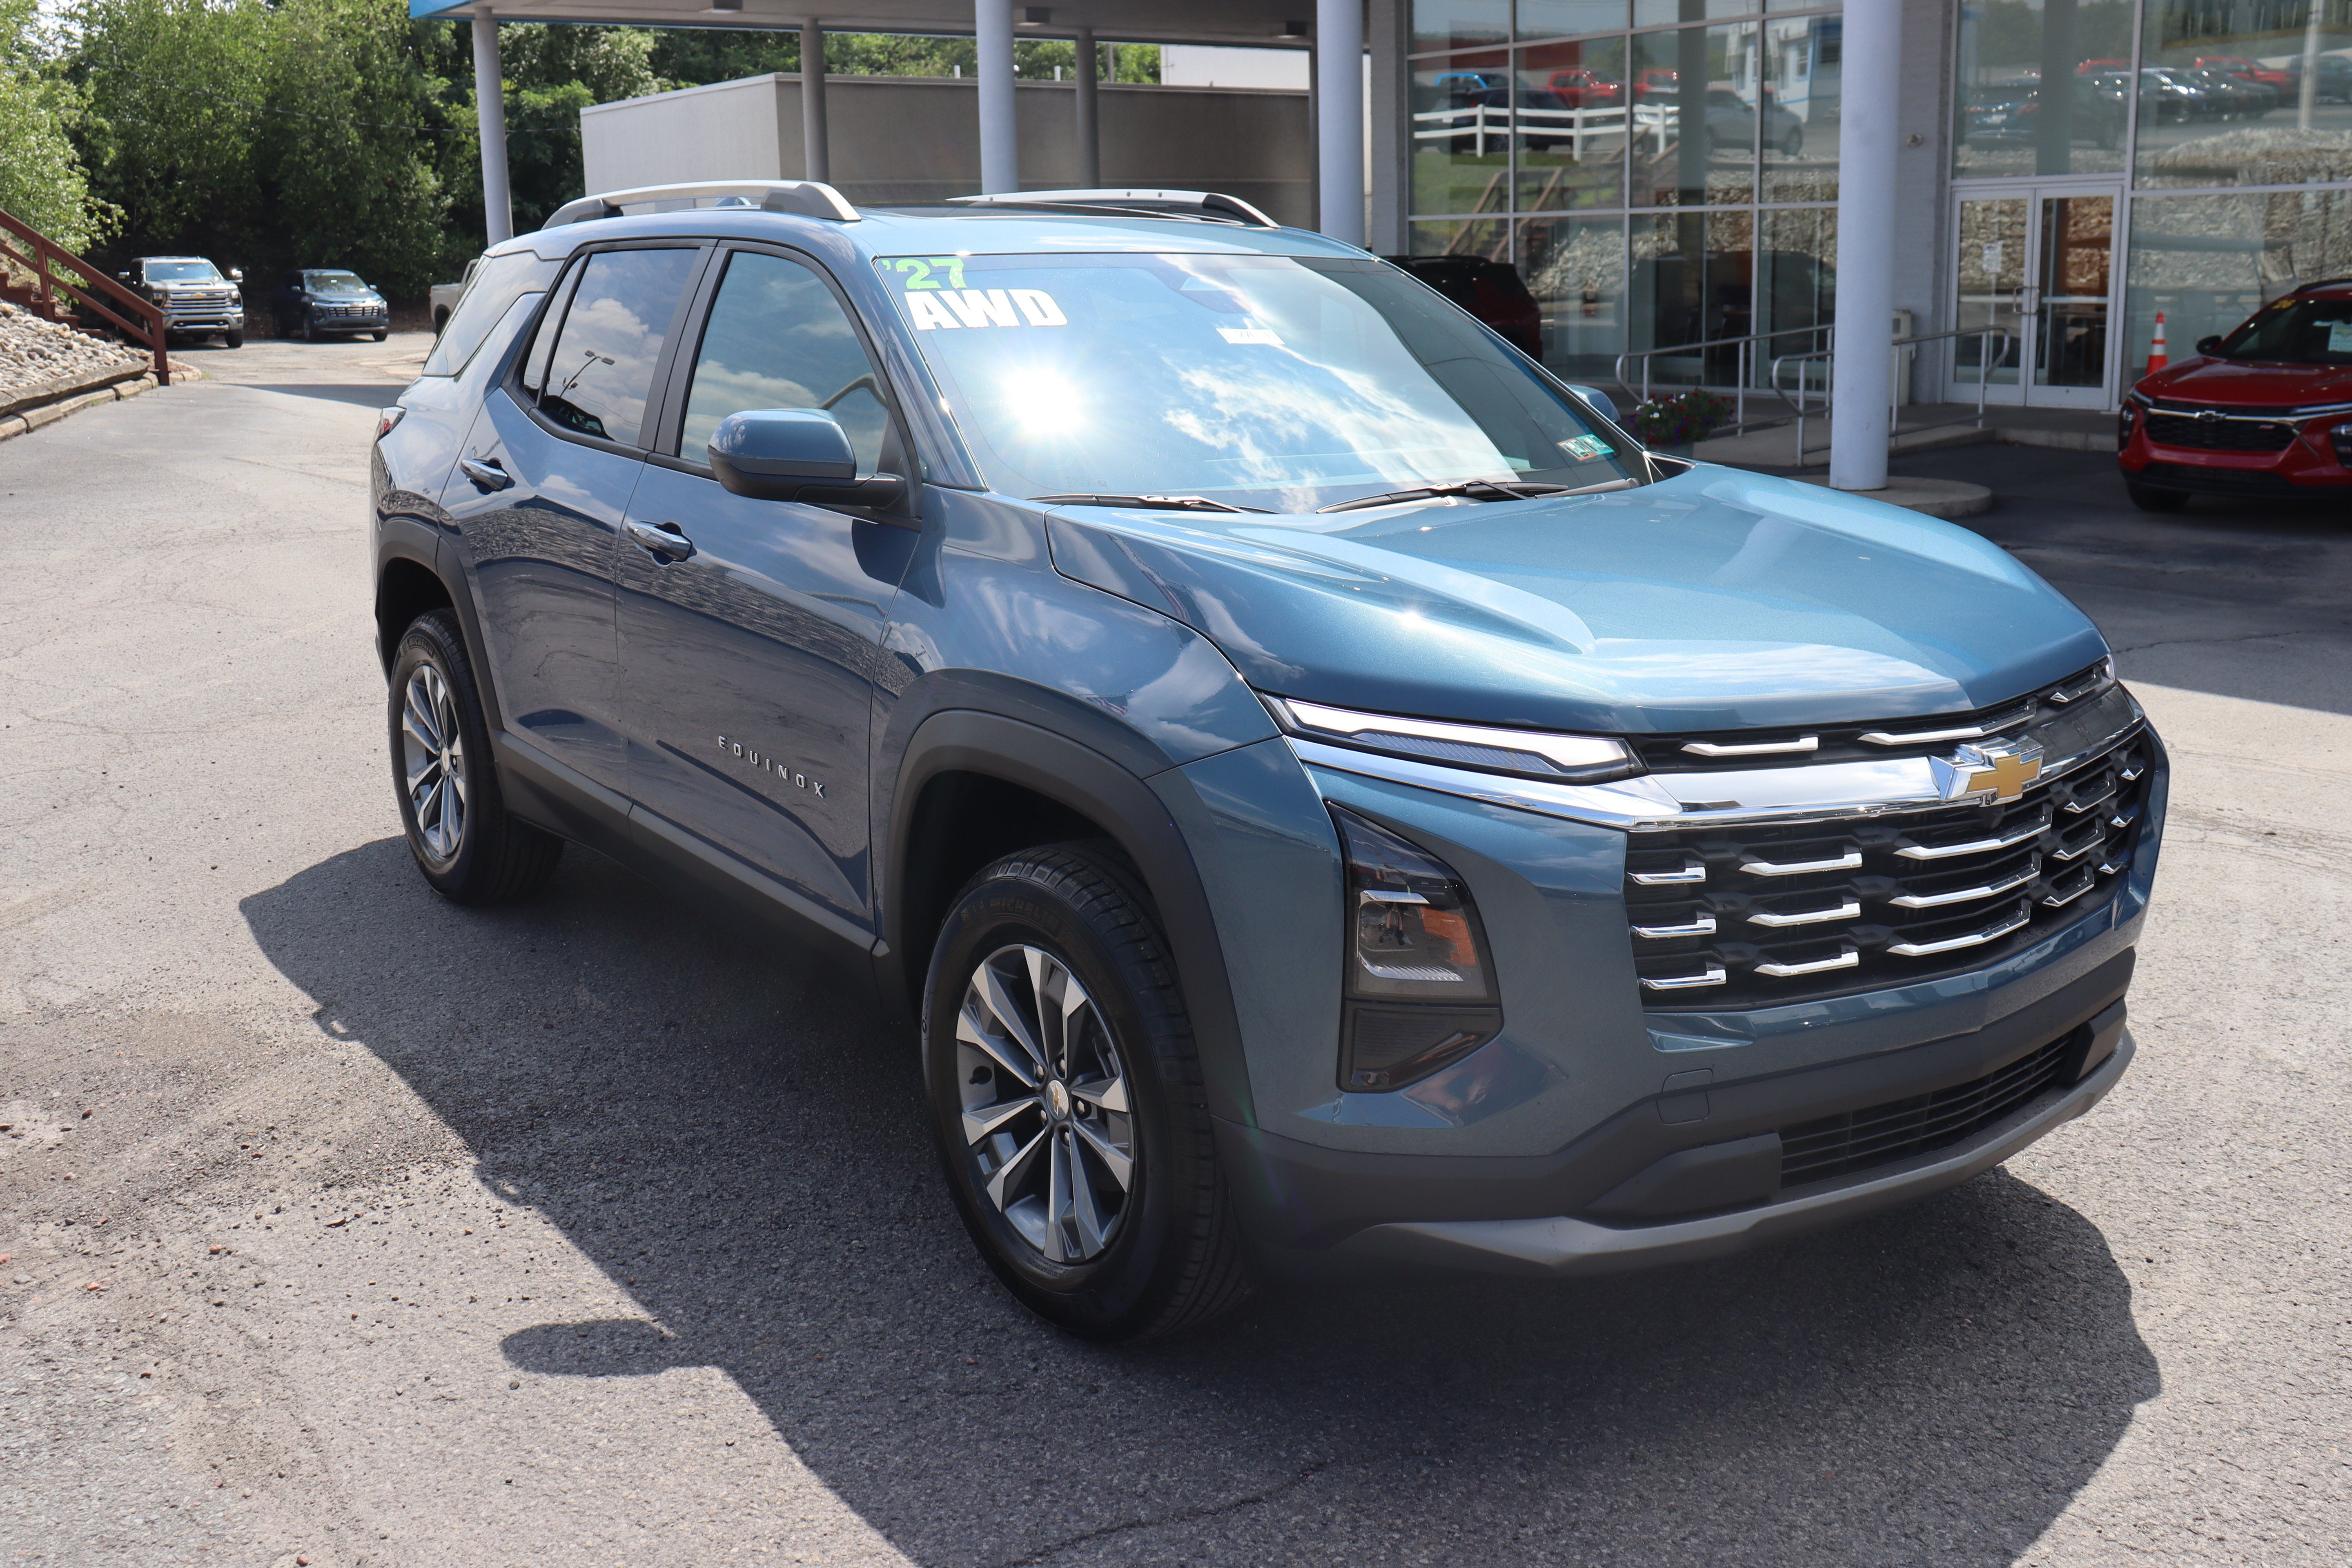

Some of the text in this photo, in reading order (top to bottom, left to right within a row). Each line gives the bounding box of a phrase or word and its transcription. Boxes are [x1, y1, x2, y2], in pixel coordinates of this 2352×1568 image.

[904, 289, 1068, 331] AWD
[718, 735, 825, 799] EQUINOX
[989, 898, 1060, 932] MICHELIN
